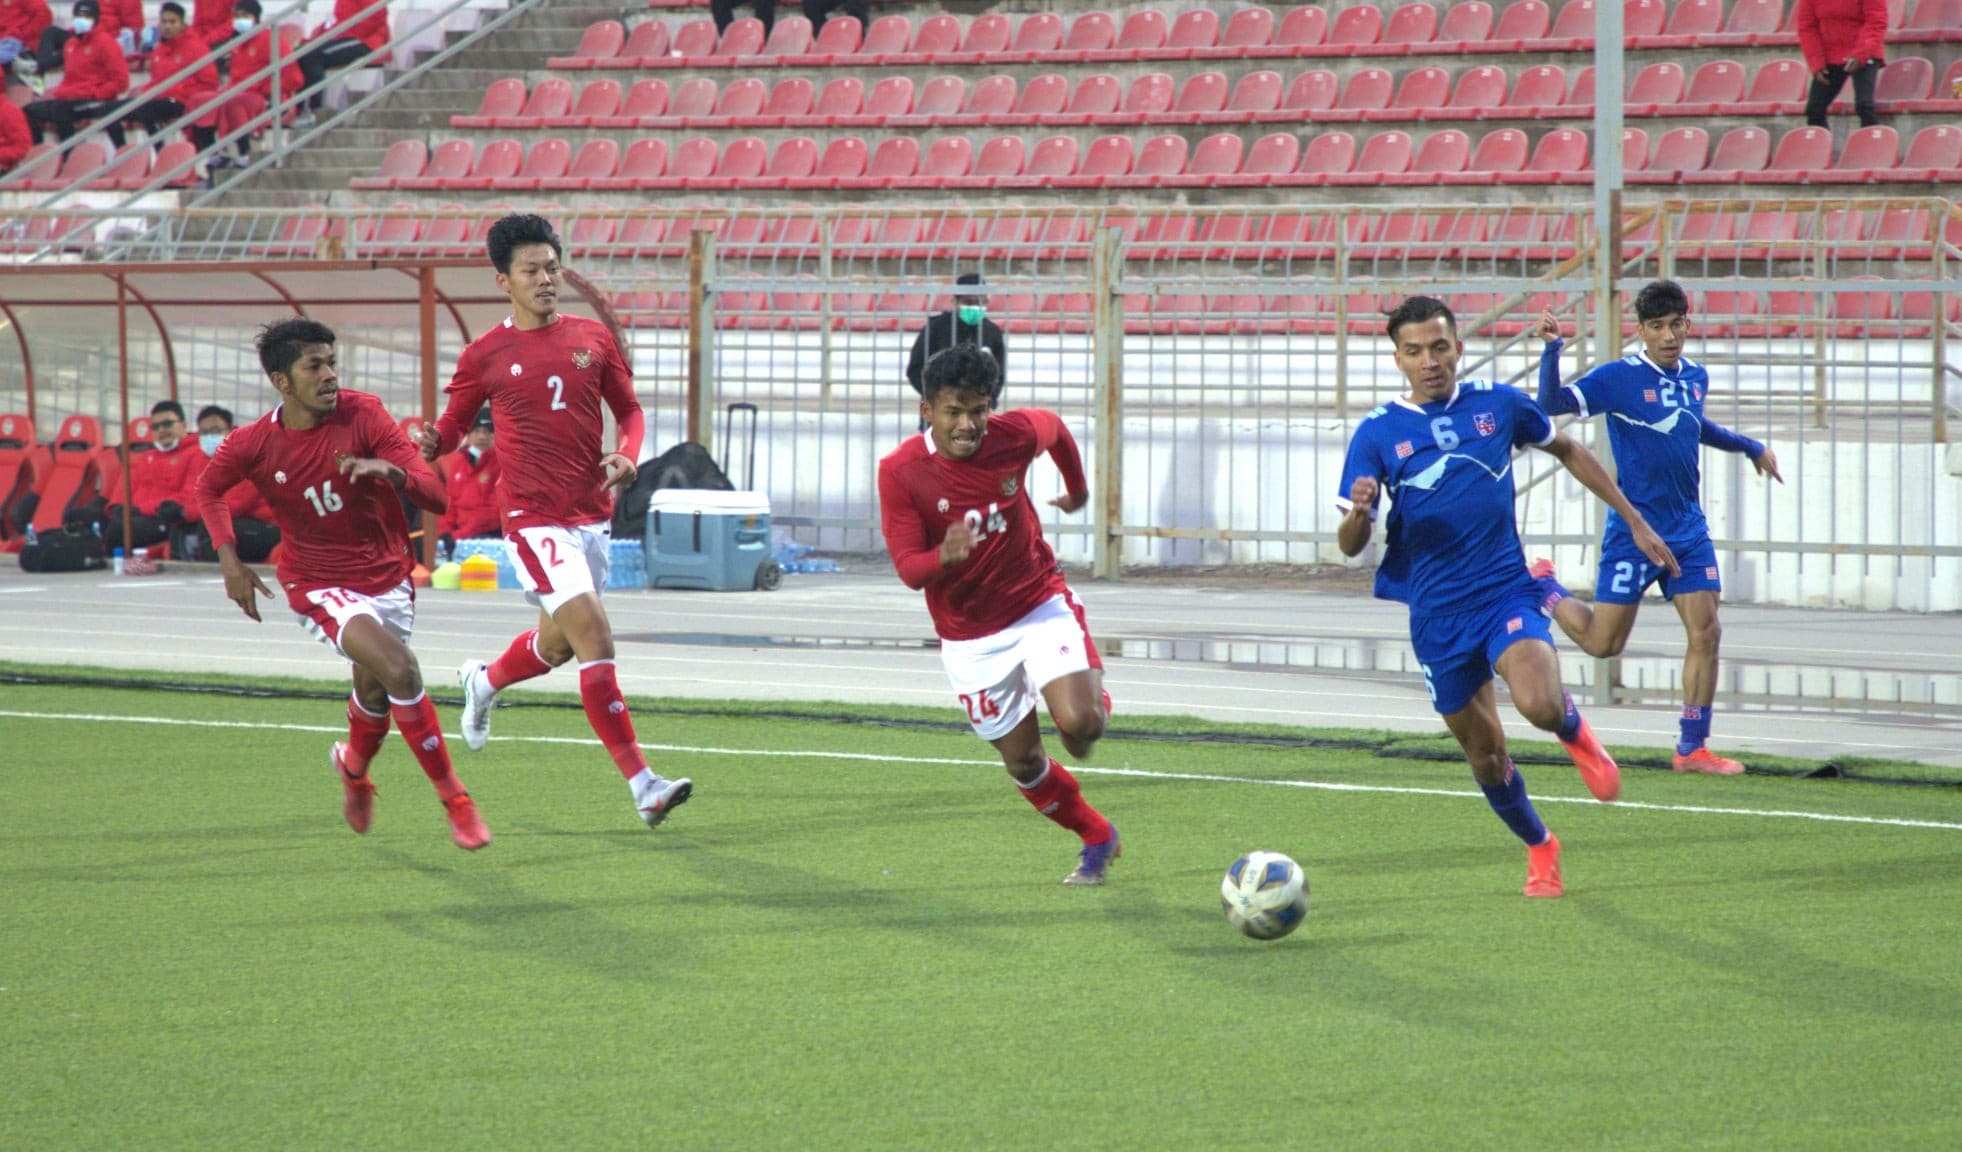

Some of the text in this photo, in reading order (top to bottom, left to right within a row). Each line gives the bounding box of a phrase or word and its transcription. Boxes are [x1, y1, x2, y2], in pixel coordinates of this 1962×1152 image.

[546, 375, 568, 411] 2
[1658, 376, 1690, 408] 21
[1430, 416, 1460, 450] 6
[303, 480, 344, 518] 16
[963, 502, 1008, 544] 24
[541, 537, 565, 569] 2
[958, 689, 1001, 725] 24
